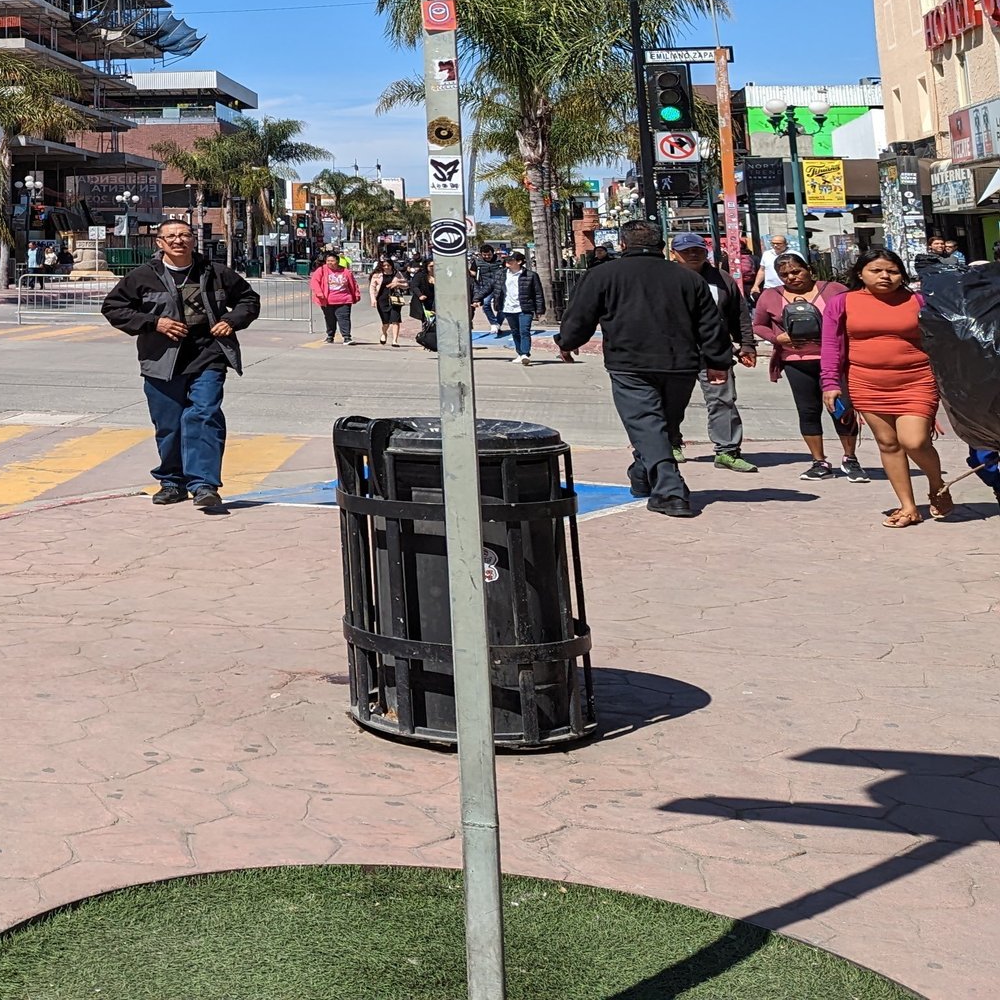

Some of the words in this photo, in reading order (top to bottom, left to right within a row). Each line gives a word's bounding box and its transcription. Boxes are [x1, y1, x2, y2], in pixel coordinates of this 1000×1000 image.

[650, 52, 690, 60] EMILIANO
[692, 52, 714, 60] ZAPA
[930, 168, 971, 186] INTERNET
